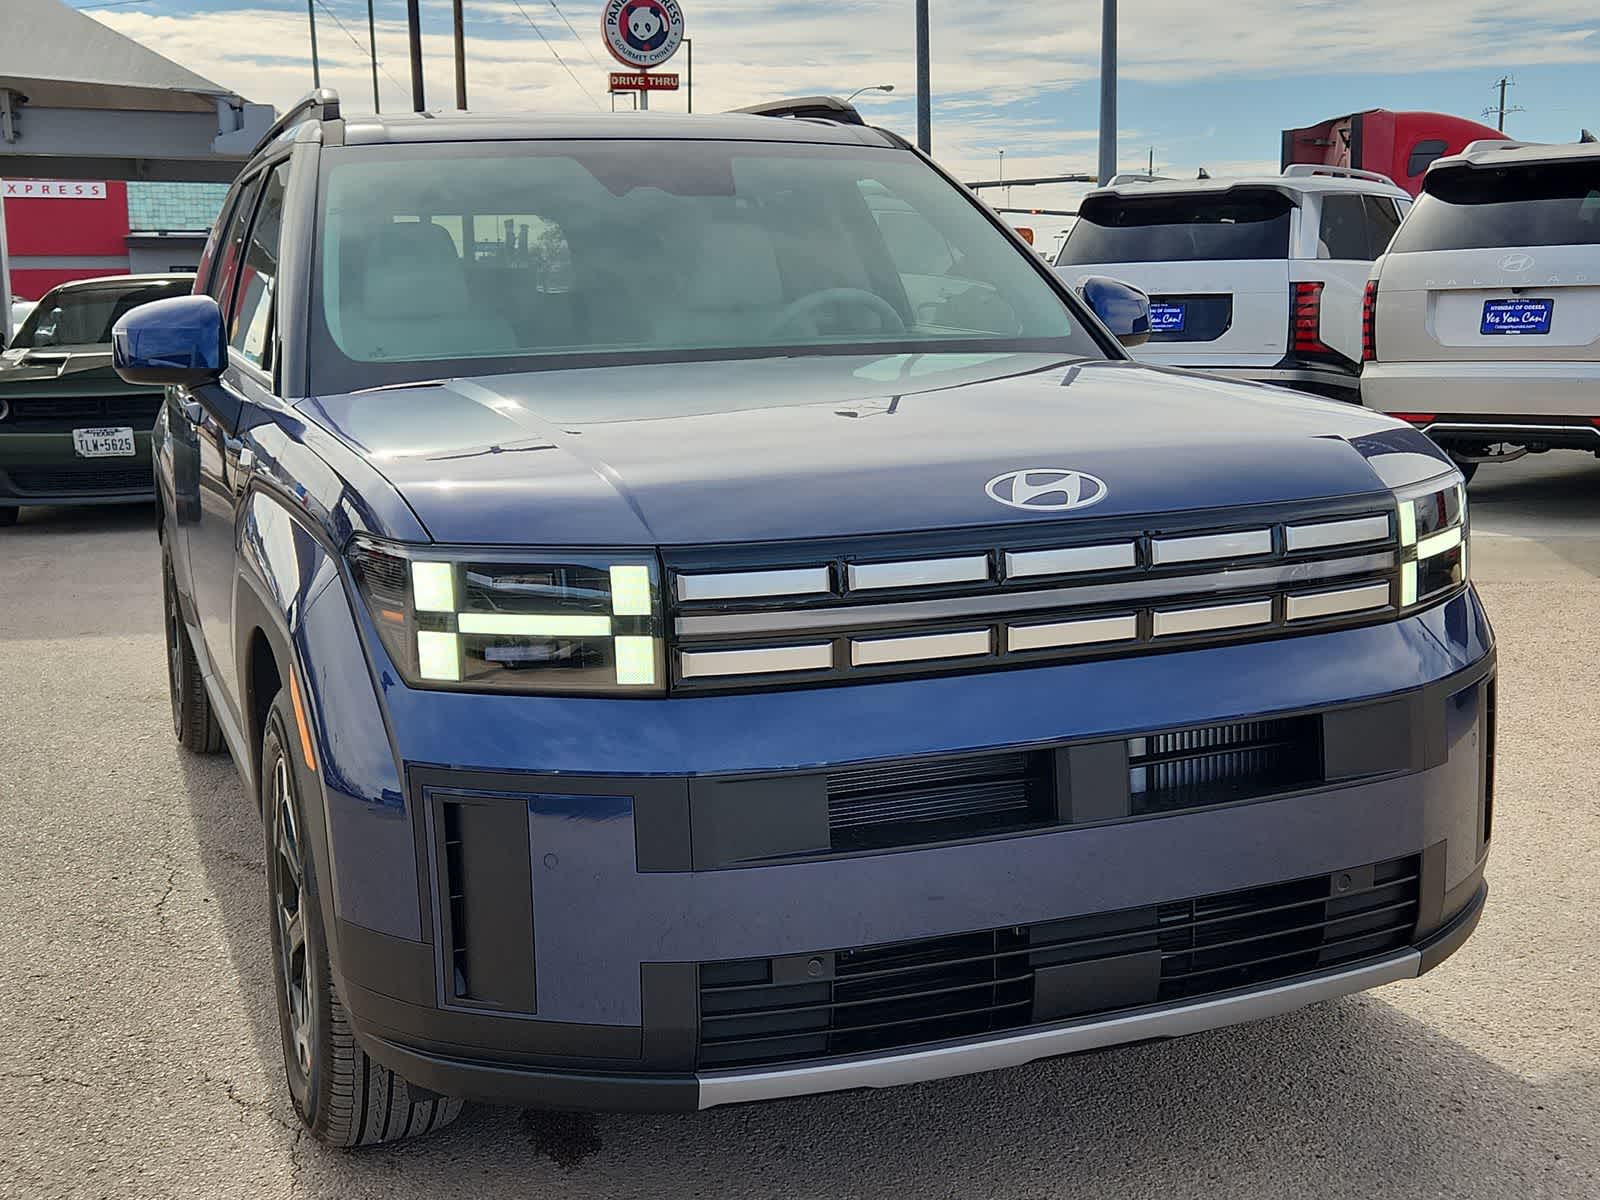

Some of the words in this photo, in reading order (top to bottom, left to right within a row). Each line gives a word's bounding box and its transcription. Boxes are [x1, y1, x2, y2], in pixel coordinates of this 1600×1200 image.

[614, 39, 647, 61] GOURMET
[650, 40, 676, 61] CHINESE
[611, 76, 645, 85] DRIVE
[647, 77, 678, 86] THRU
[7, 185, 99, 195] XPRESS
[1162, 314, 1182, 323] Can!
[1486, 312, 1500, 323] Yes
[1503, 312, 1520, 323] You
[1521, 311, 1547, 323] Can!
